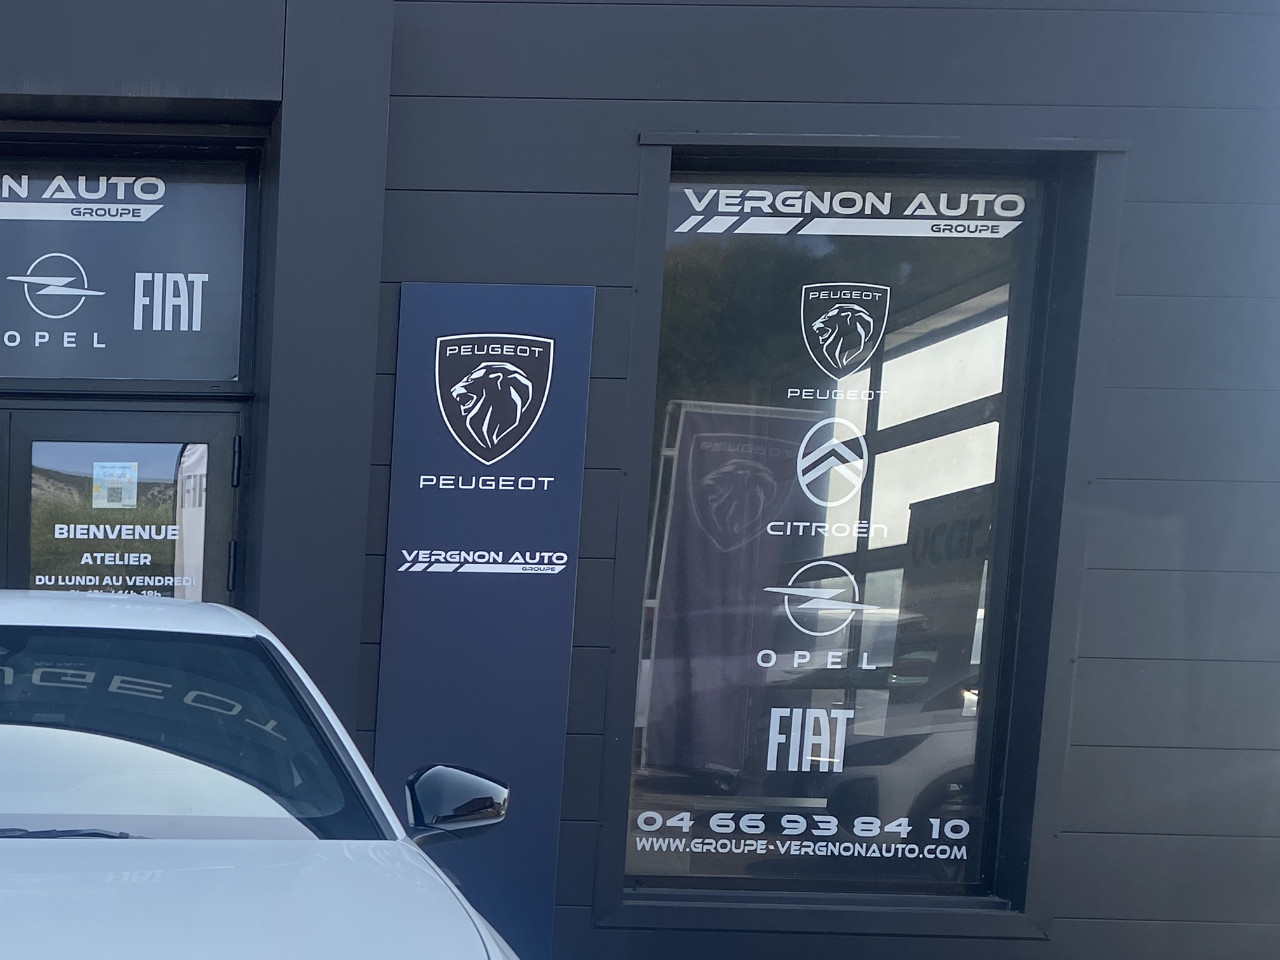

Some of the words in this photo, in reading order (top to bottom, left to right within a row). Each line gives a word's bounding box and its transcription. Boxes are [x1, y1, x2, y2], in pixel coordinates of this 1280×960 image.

[41, 175, 166, 200] AUTO
[683, 188, 892, 216] VERGNON
[903, 192, 1026, 217] AUTO
[70, 207, 142, 219] GROUPE
[930, 223, 1000, 234] GROUPE
[133, 272, 208, 331] FIAT
[809, 290, 882, 302] PEUGEOT
[3, 330, 106, 348] OPEL
[446, 344, 543, 358] PEUGEOT
[787, 388, 888, 401] PEUGEOT
[420, 475, 555, 491] PEUGEOT
[54, 524, 180, 540] BIENVENUE
[766, 521, 888, 538] CITROËN
[80, 553, 152, 566] ATELIER
[401, 550, 502, 563] VERGNON
[508, 551, 568, 564] AUTO
[35, 575, 55, 585] DU
[58, 576, 99, 586] LUNDI
[102, 576, 123, 586] AU
[125, 576, 197, 587] VENDREDI
[756, 649, 877, 670] OPEL
[766, 707, 855, 773] FIAT
[637, 811, 694, 832] 04
[709, 813, 766, 834] 66
[780, 815, 838, 836] 93
[853, 817, 912, 838] 84
[930, 818, 970, 840] 10
[636, 837, 968, 860] WWW.GROUPE-VERGNONAUTO.COM
